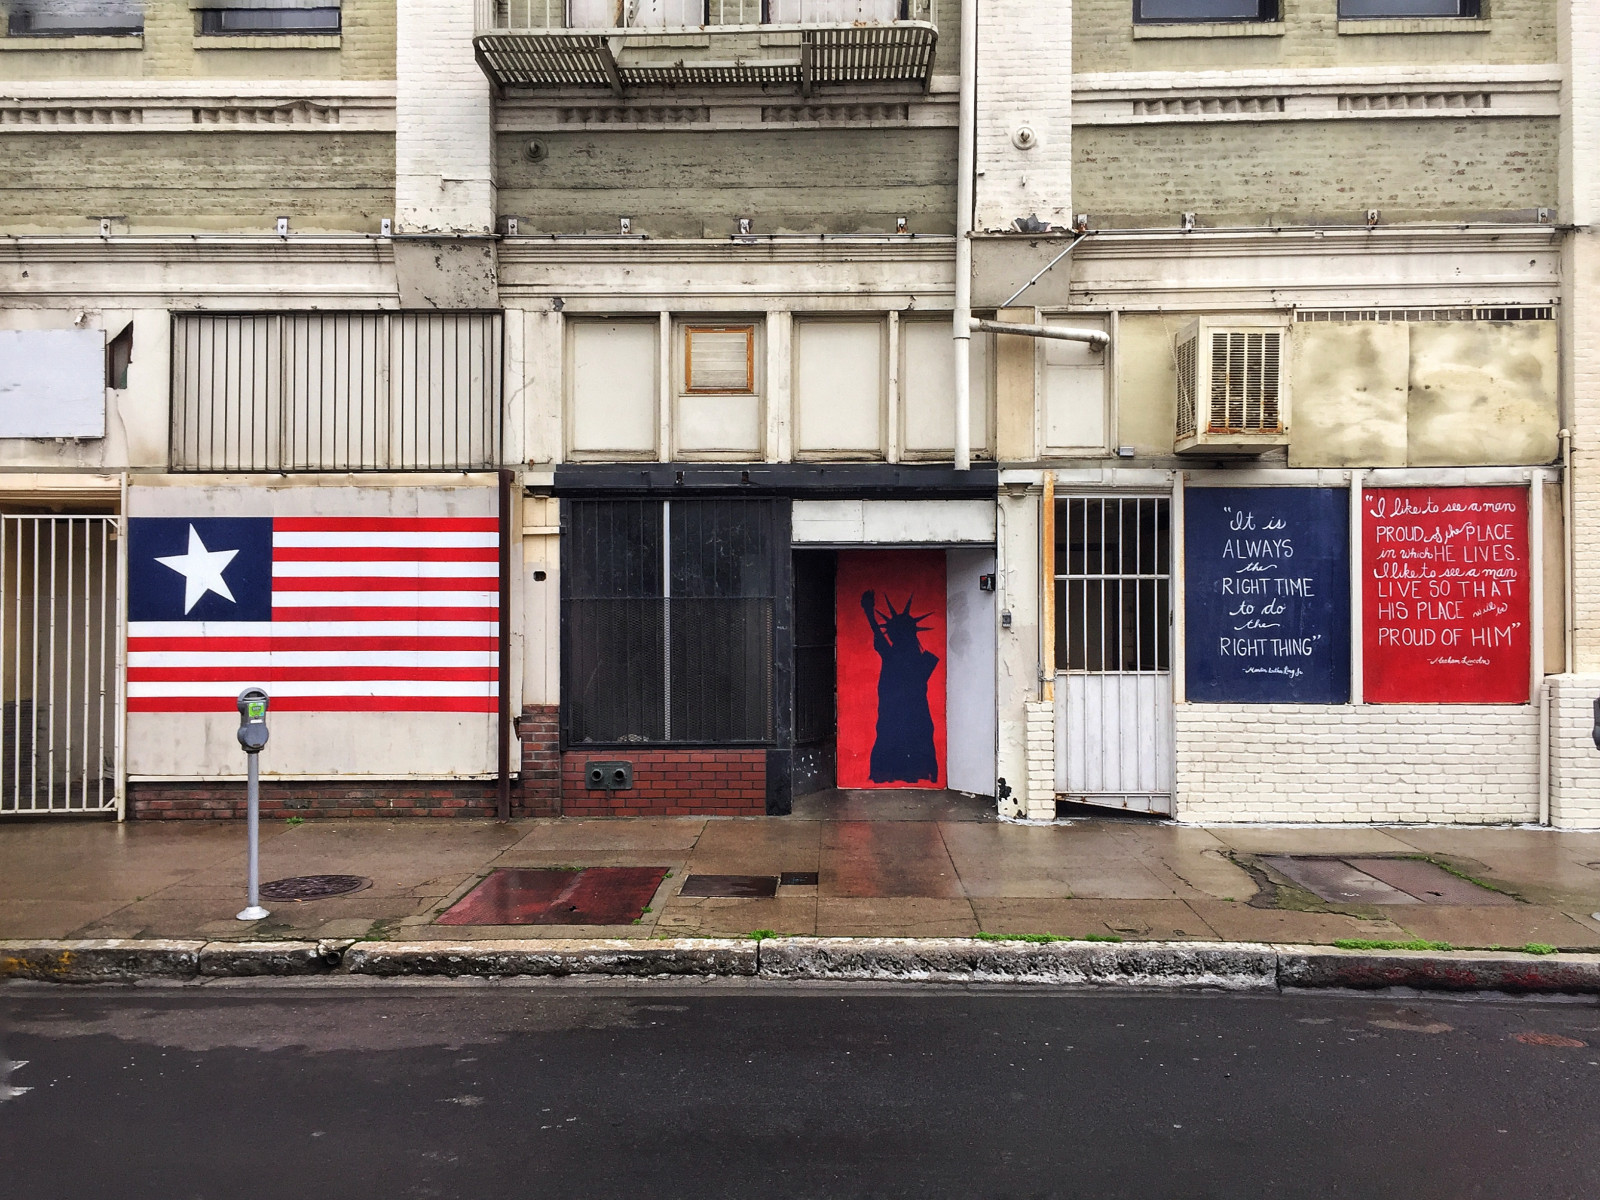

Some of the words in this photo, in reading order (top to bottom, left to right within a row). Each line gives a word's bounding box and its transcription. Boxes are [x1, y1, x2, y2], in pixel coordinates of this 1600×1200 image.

[1390, 497, 1422, 518] like
[1421, 496, 1439, 515] to
[1442, 502, 1467, 512] see
[1467, 501, 1482, 512] a
[1482, 501, 1516, 513] man
[1262, 516, 1287, 530] is
[1376, 525, 1424, 543] PROUD
[1423, 526, 1443, 543] of
[1444, 521, 1472, 544] the
[1465, 524, 1515, 541] PLACE
[1222, 539, 1294, 558] ALWAYS
[1376, 547, 1396, 560] in
[1399, 547, 1433, 559] which
[1434, 545, 1456, 562] HE
[1464, 544, 1520, 563] LIVES.
[1236, 562, 1277, 573] the
[1373, 562, 1389, 579] I
[1389, 562, 1419, 579] like
[1418, 564, 1437, 579] to
[1438, 567, 1465, 578] see
[1465, 567, 1480, 577] a
[1482, 567, 1517, 578] man
[1222, 577, 1270, 595] RIGHT
[1274, 578, 1315, 597] TIME
[1378, 580, 1422, 599] LIVE
[1429, 580, 1451, 597] SO
[1457, 579, 1516, 598] THAT
[1229, 600, 1255, 616] to
[1261, 598, 1286, 615] do
[1378, 601, 1408, 620] HIS
[1417, 601, 1464, 620] PLACE
[1472, 601, 1496, 618] will
[1234, 619, 1280, 630] the
[1378, 627, 1436, 647] PROUD
[1441, 628, 1464, 646] OF
[1220, 637, 1268, 657] RIGHT
[1461, 656, 1490, 666] Lincoln
